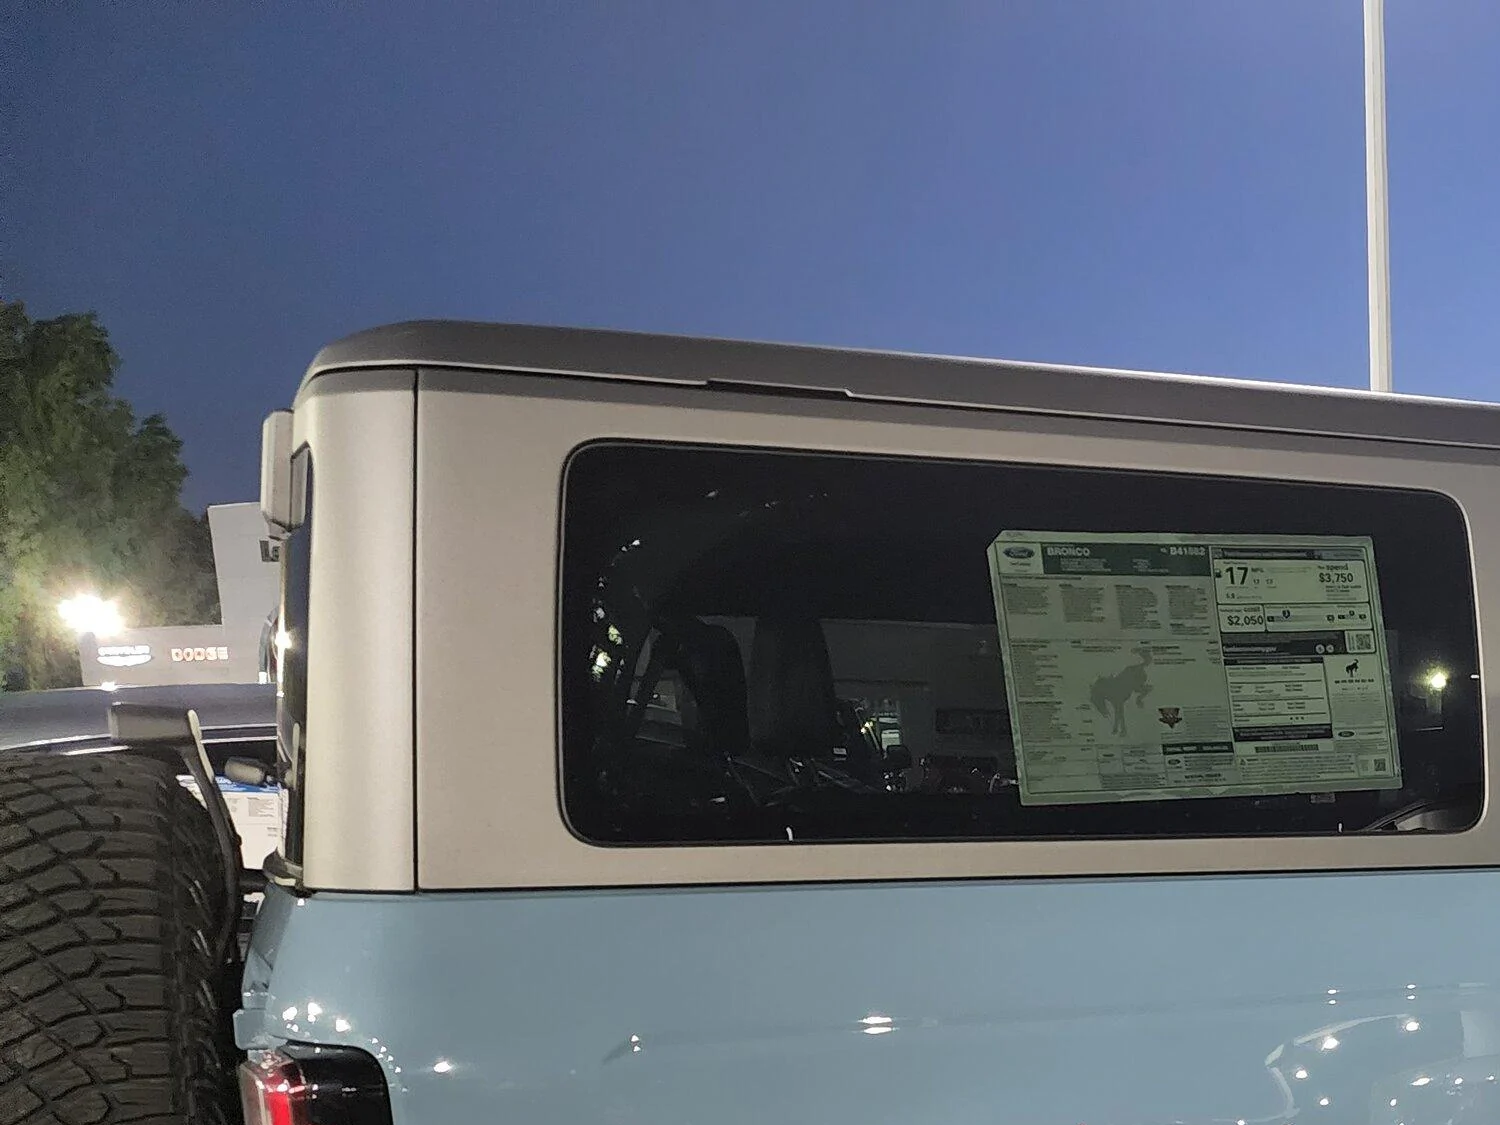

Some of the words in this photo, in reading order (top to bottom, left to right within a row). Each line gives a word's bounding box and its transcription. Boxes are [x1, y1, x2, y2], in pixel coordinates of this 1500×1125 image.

[1047, 546, 1090, 557] BRONCO
[1326, 563, 1349, 571] spend
[1225, 566, 1249, 585] 17
[1319, 572, 1354, 583] $3,750
[1227, 615, 1264, 627] $2,050
[171, 646, 229, 662] DODGE
